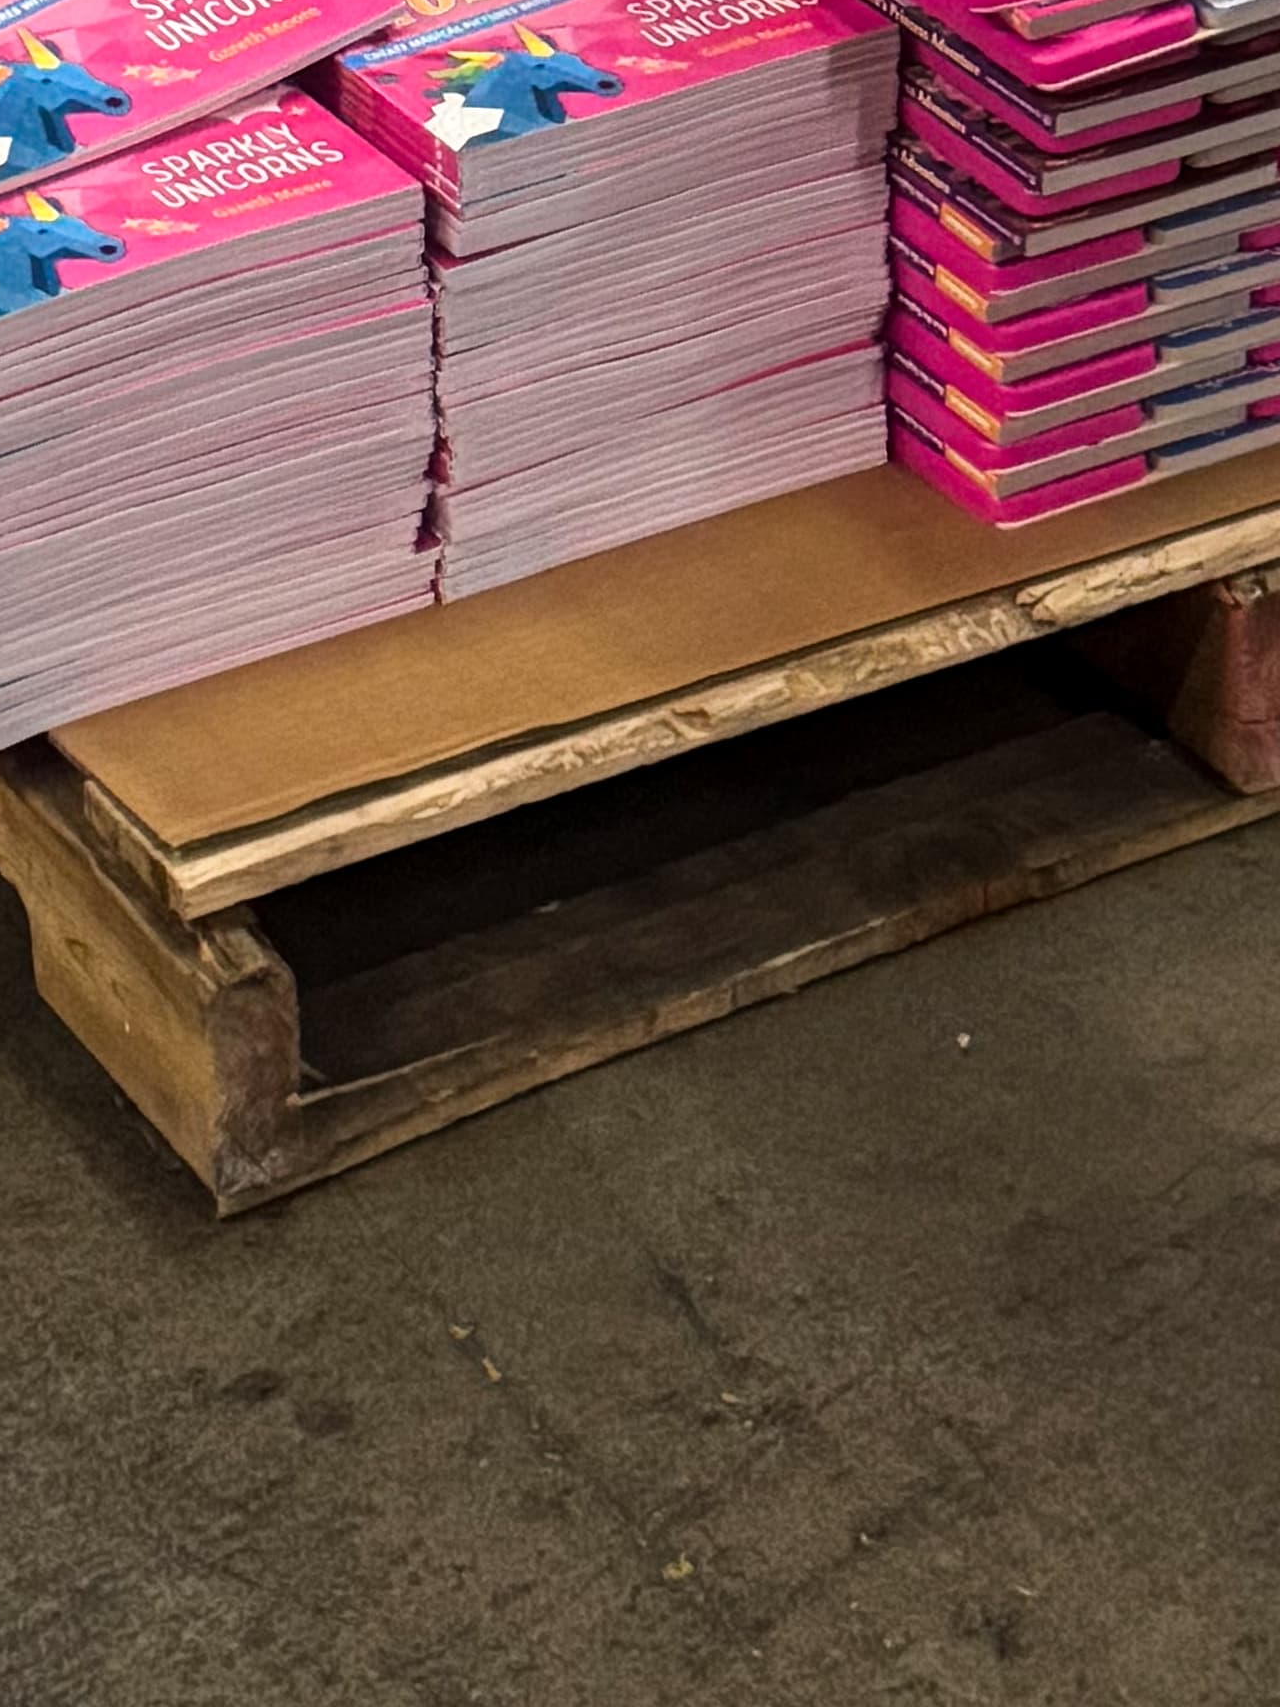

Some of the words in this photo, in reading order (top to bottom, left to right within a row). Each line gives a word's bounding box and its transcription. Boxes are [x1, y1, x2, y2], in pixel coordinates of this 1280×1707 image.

[208, 28, 264, 63] Gareth
[141, 123, 302, 185] SPARKLY
[152, 140, 346, 210] UNICORNS
